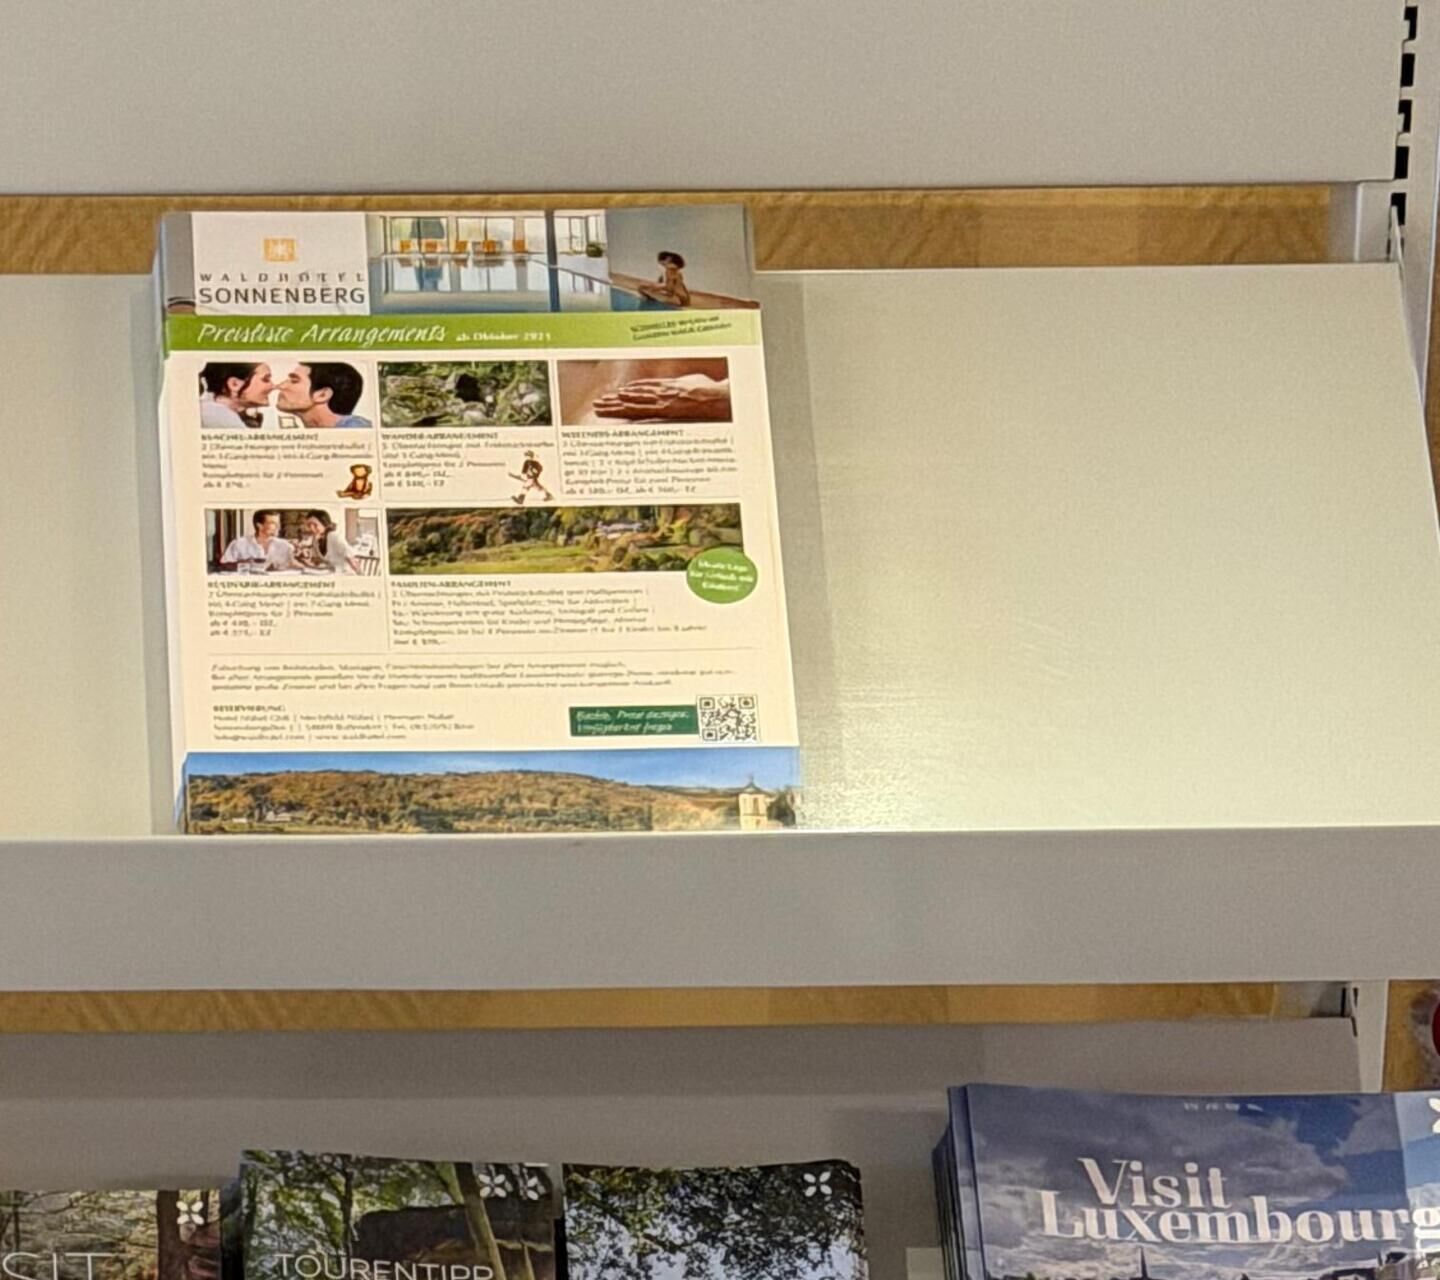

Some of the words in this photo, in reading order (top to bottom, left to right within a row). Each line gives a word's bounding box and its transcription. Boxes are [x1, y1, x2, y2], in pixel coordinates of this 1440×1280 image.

[199, 271, 366, 283] WALDHOTEL
[199, 286, 366, 306] SONNENBERG
[299, 322, 447, 349] Arrangements
[1076, 1156, 1234, 1211] Visit
[1036, 1188, 1440, 1268] Luxembourg
